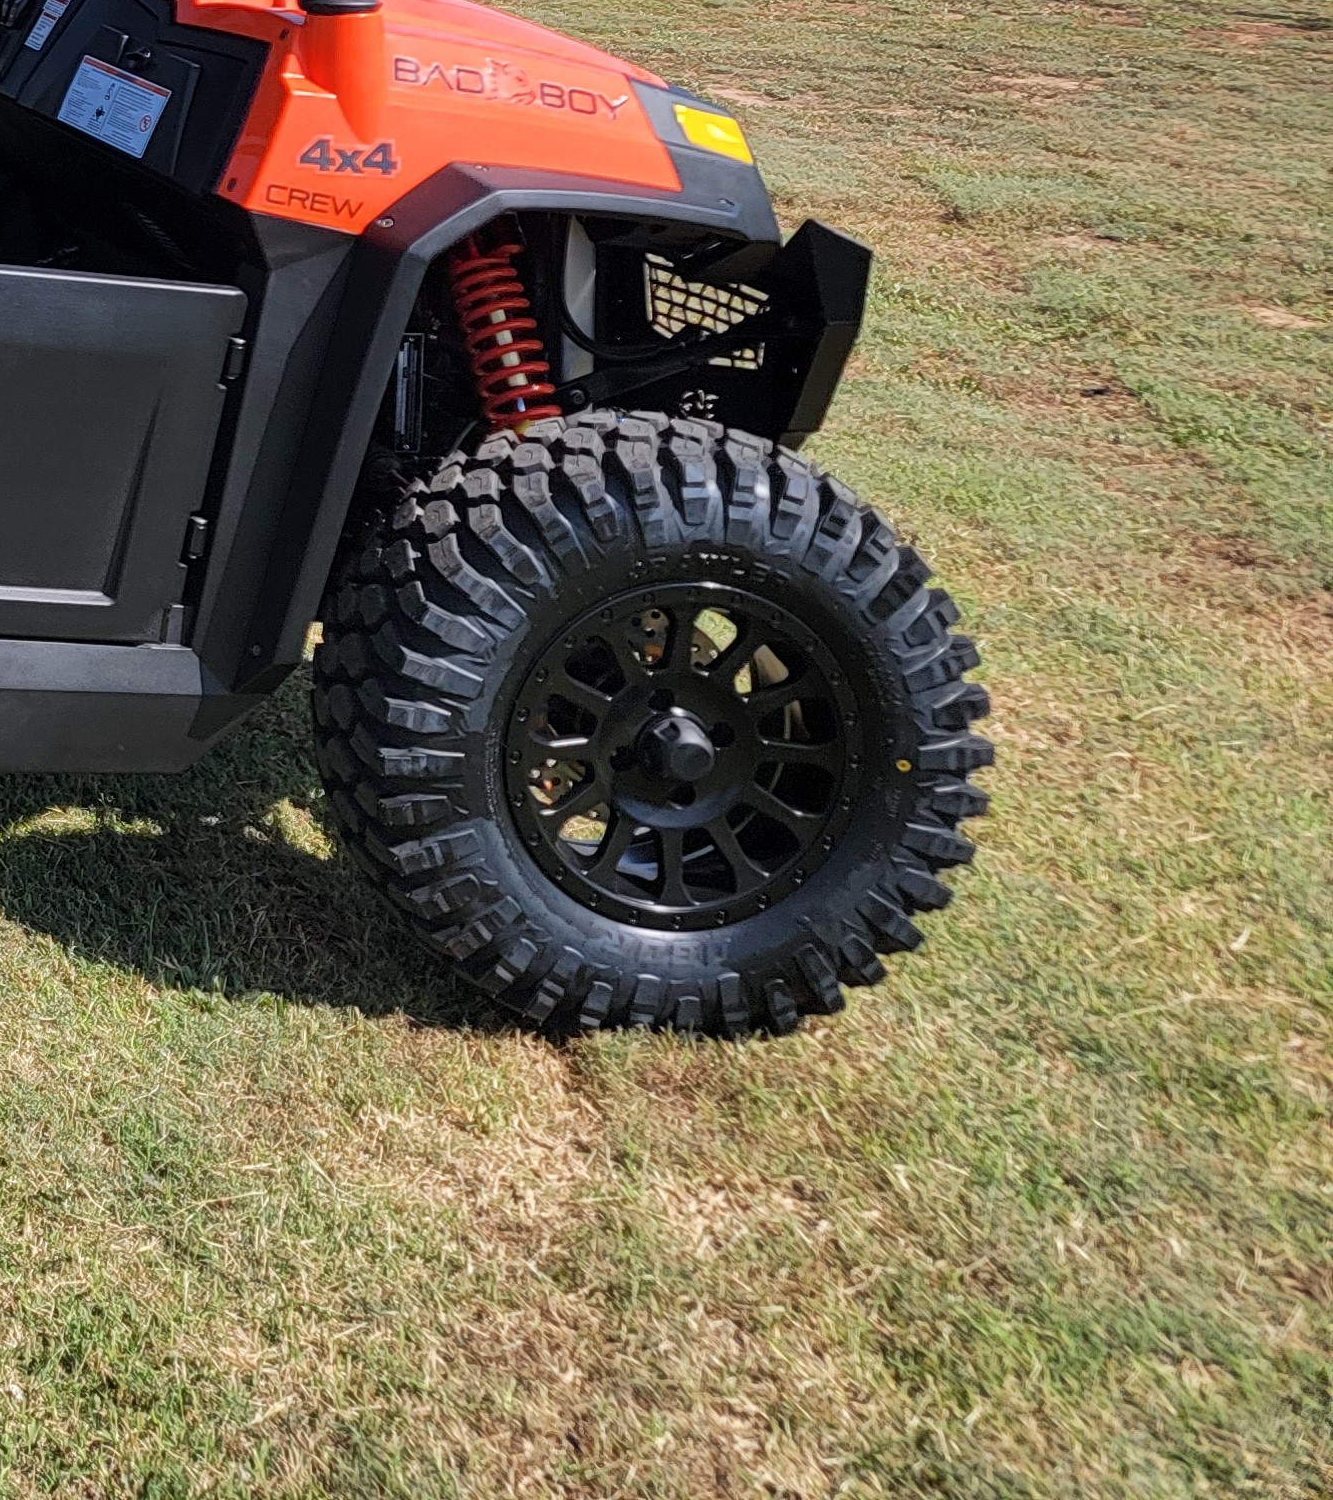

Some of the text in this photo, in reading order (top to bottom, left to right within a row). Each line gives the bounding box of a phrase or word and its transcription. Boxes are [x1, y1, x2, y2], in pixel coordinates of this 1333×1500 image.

[393, 57, 629, 120] BAD BOY
[300, 140, 398, 175] 4x4
[266, 184, 365, 219] CREW
